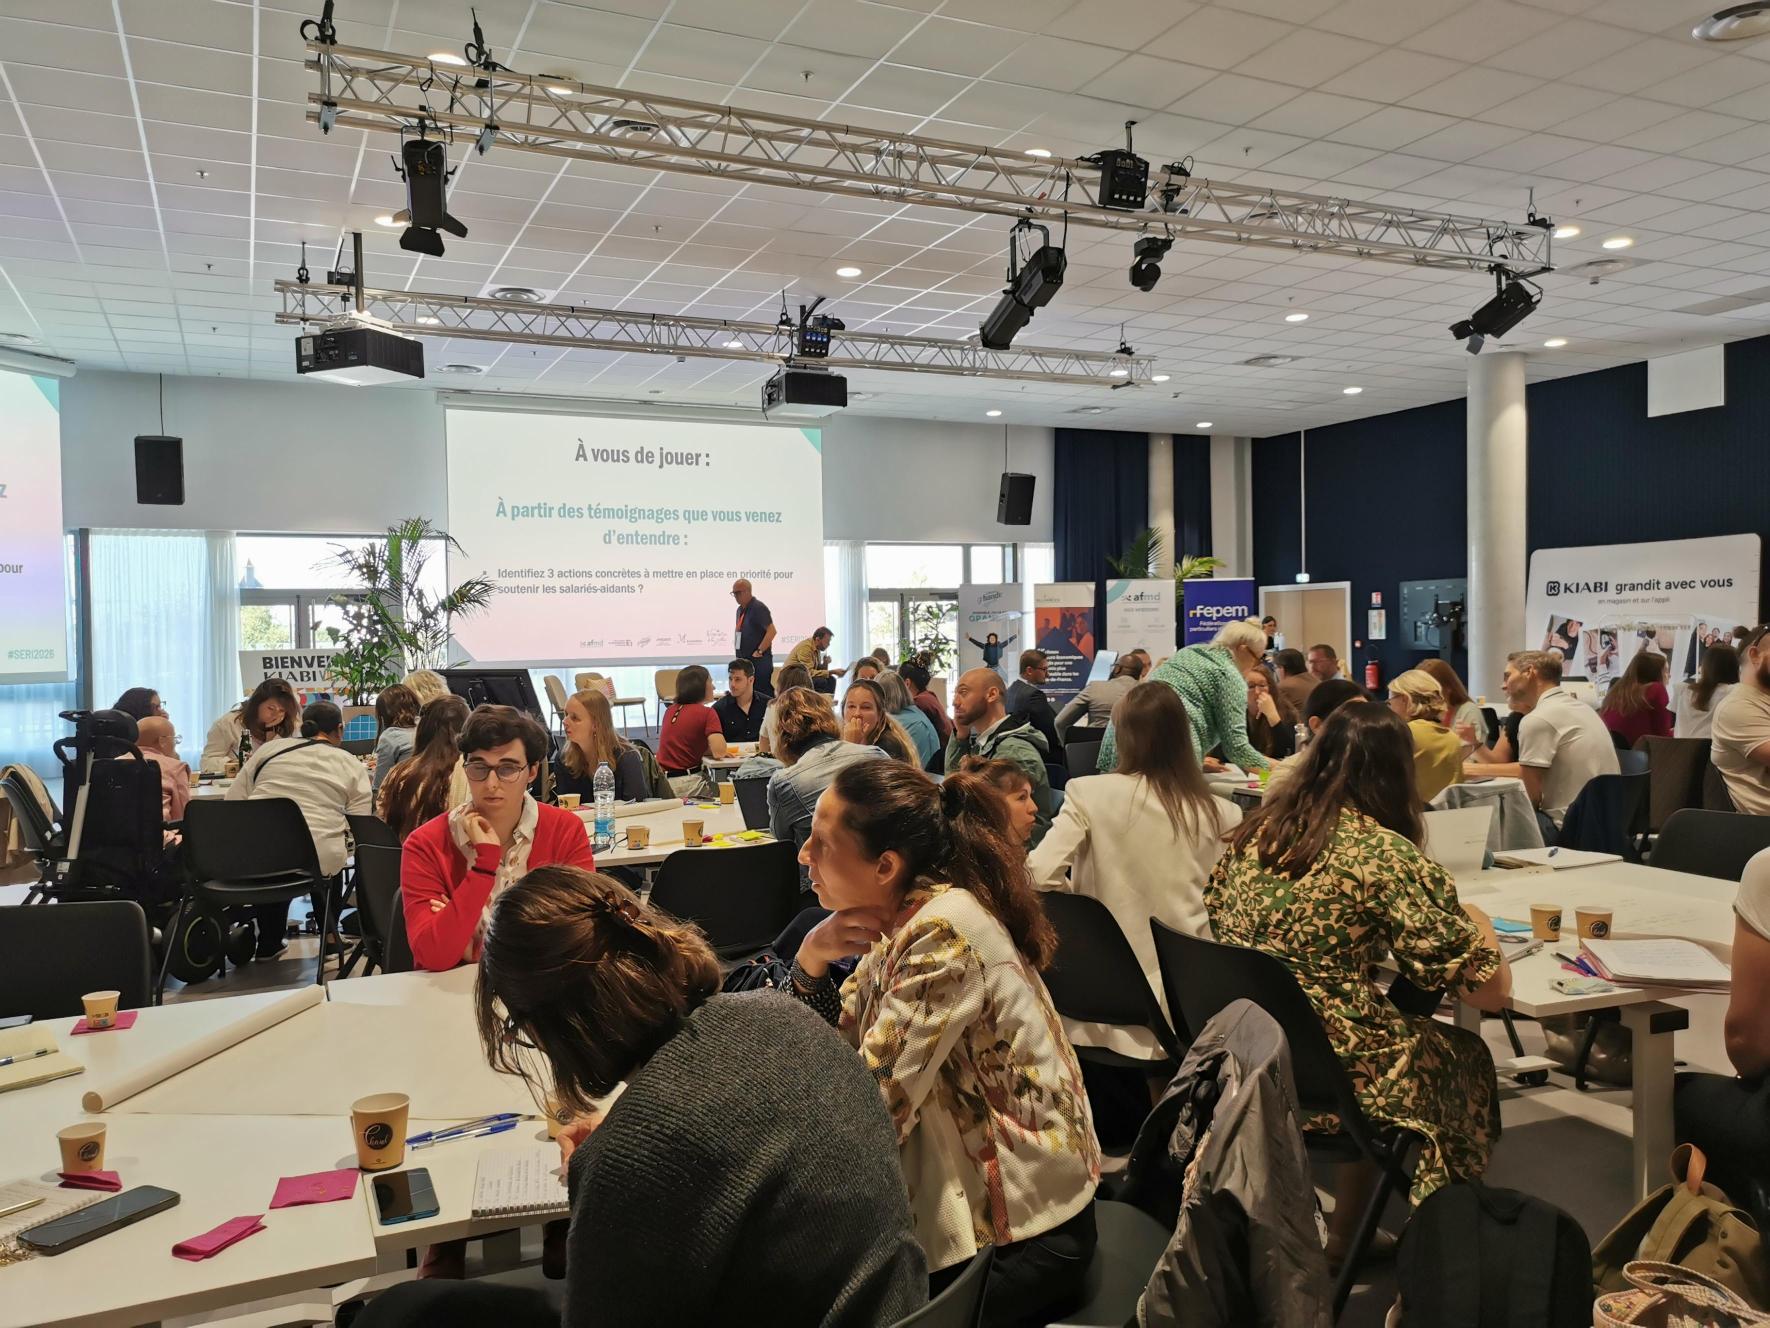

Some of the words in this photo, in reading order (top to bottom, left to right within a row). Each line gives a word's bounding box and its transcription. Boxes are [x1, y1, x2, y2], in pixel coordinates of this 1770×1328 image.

[575, 437, 589, 462] À
[591, 447, 630, 463] vous
[635, 445, 655, 464] de
[659, 446, 701, 469] jouer
[705, 452, 710, 467] :
[495, 495, 507, 518] À
[511, 502, 555, 521] partir
[558, 502, 584, 519] des
[587, 502, 680, 524] témoignages
[683, 508, 709, 524] que
[711, 509, 742, 522] vous
[745, 510, 783, 524] venez
[603, 529, 681, 545] d'entendre
[684, 533, 688, 546] :
[498, 568, 545, 579] Identifiez
[547, 568, 554, 578] 3
[557, 568, 593, 578] actions
[595, 568, 642, 579] concrètes
[644, 568, 650, 579] à
[652, 569, 684, 579] mettre
[686, 570, 697, 579] en
[700, 569, 724, 580] place
[726, 571, 738, 579] en
[740, 569, 772, 580] priorité
[774, 571, 794, 581] pour
[498, 584, 540, 594] soutenir
[542, 584, 557, 594] les
[559, 583, 636, 594] salariés-aidants
[638, 584, 644, 594] ?
[1563, 581, 1609, 594] KIABI
[1615, 579, 1661, 595] grandit
[1664, 580, 1696, 591] avec
[1700, 577, 1733, 588] vous
[1133, 591, 1161, 602] afmd
[1196, 605, 1249, 620] Fepem
[262, 655, 331, 669] BIENVE
